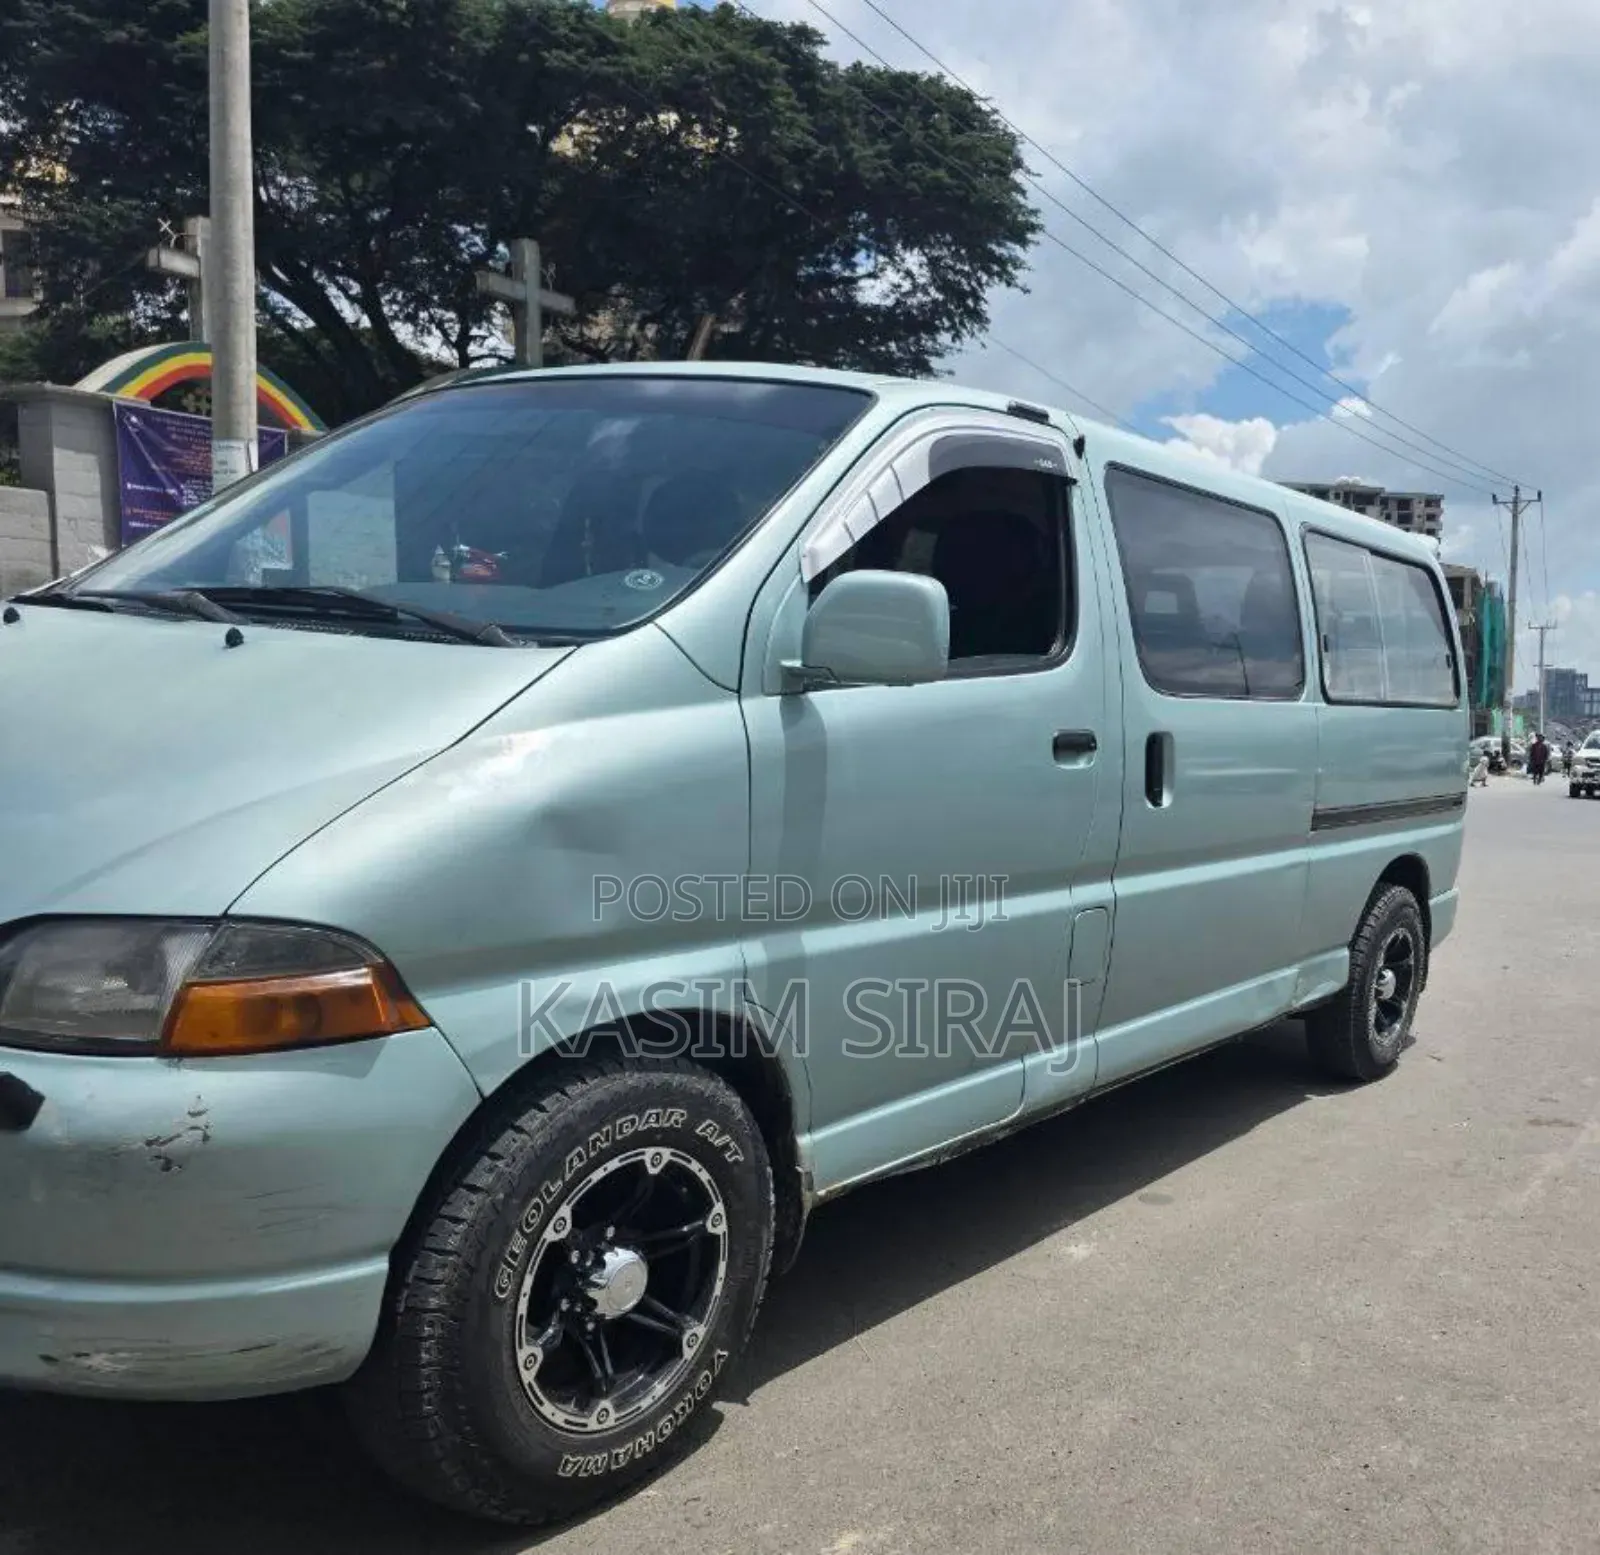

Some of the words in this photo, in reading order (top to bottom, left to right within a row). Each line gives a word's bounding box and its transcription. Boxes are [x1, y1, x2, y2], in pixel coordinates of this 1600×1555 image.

[494, 1108, 687, 1298] GEOLANDAR
[695, 1119, 744, 1163] A/T
[556, 1349, 729, 1477] YOKOHAMA
